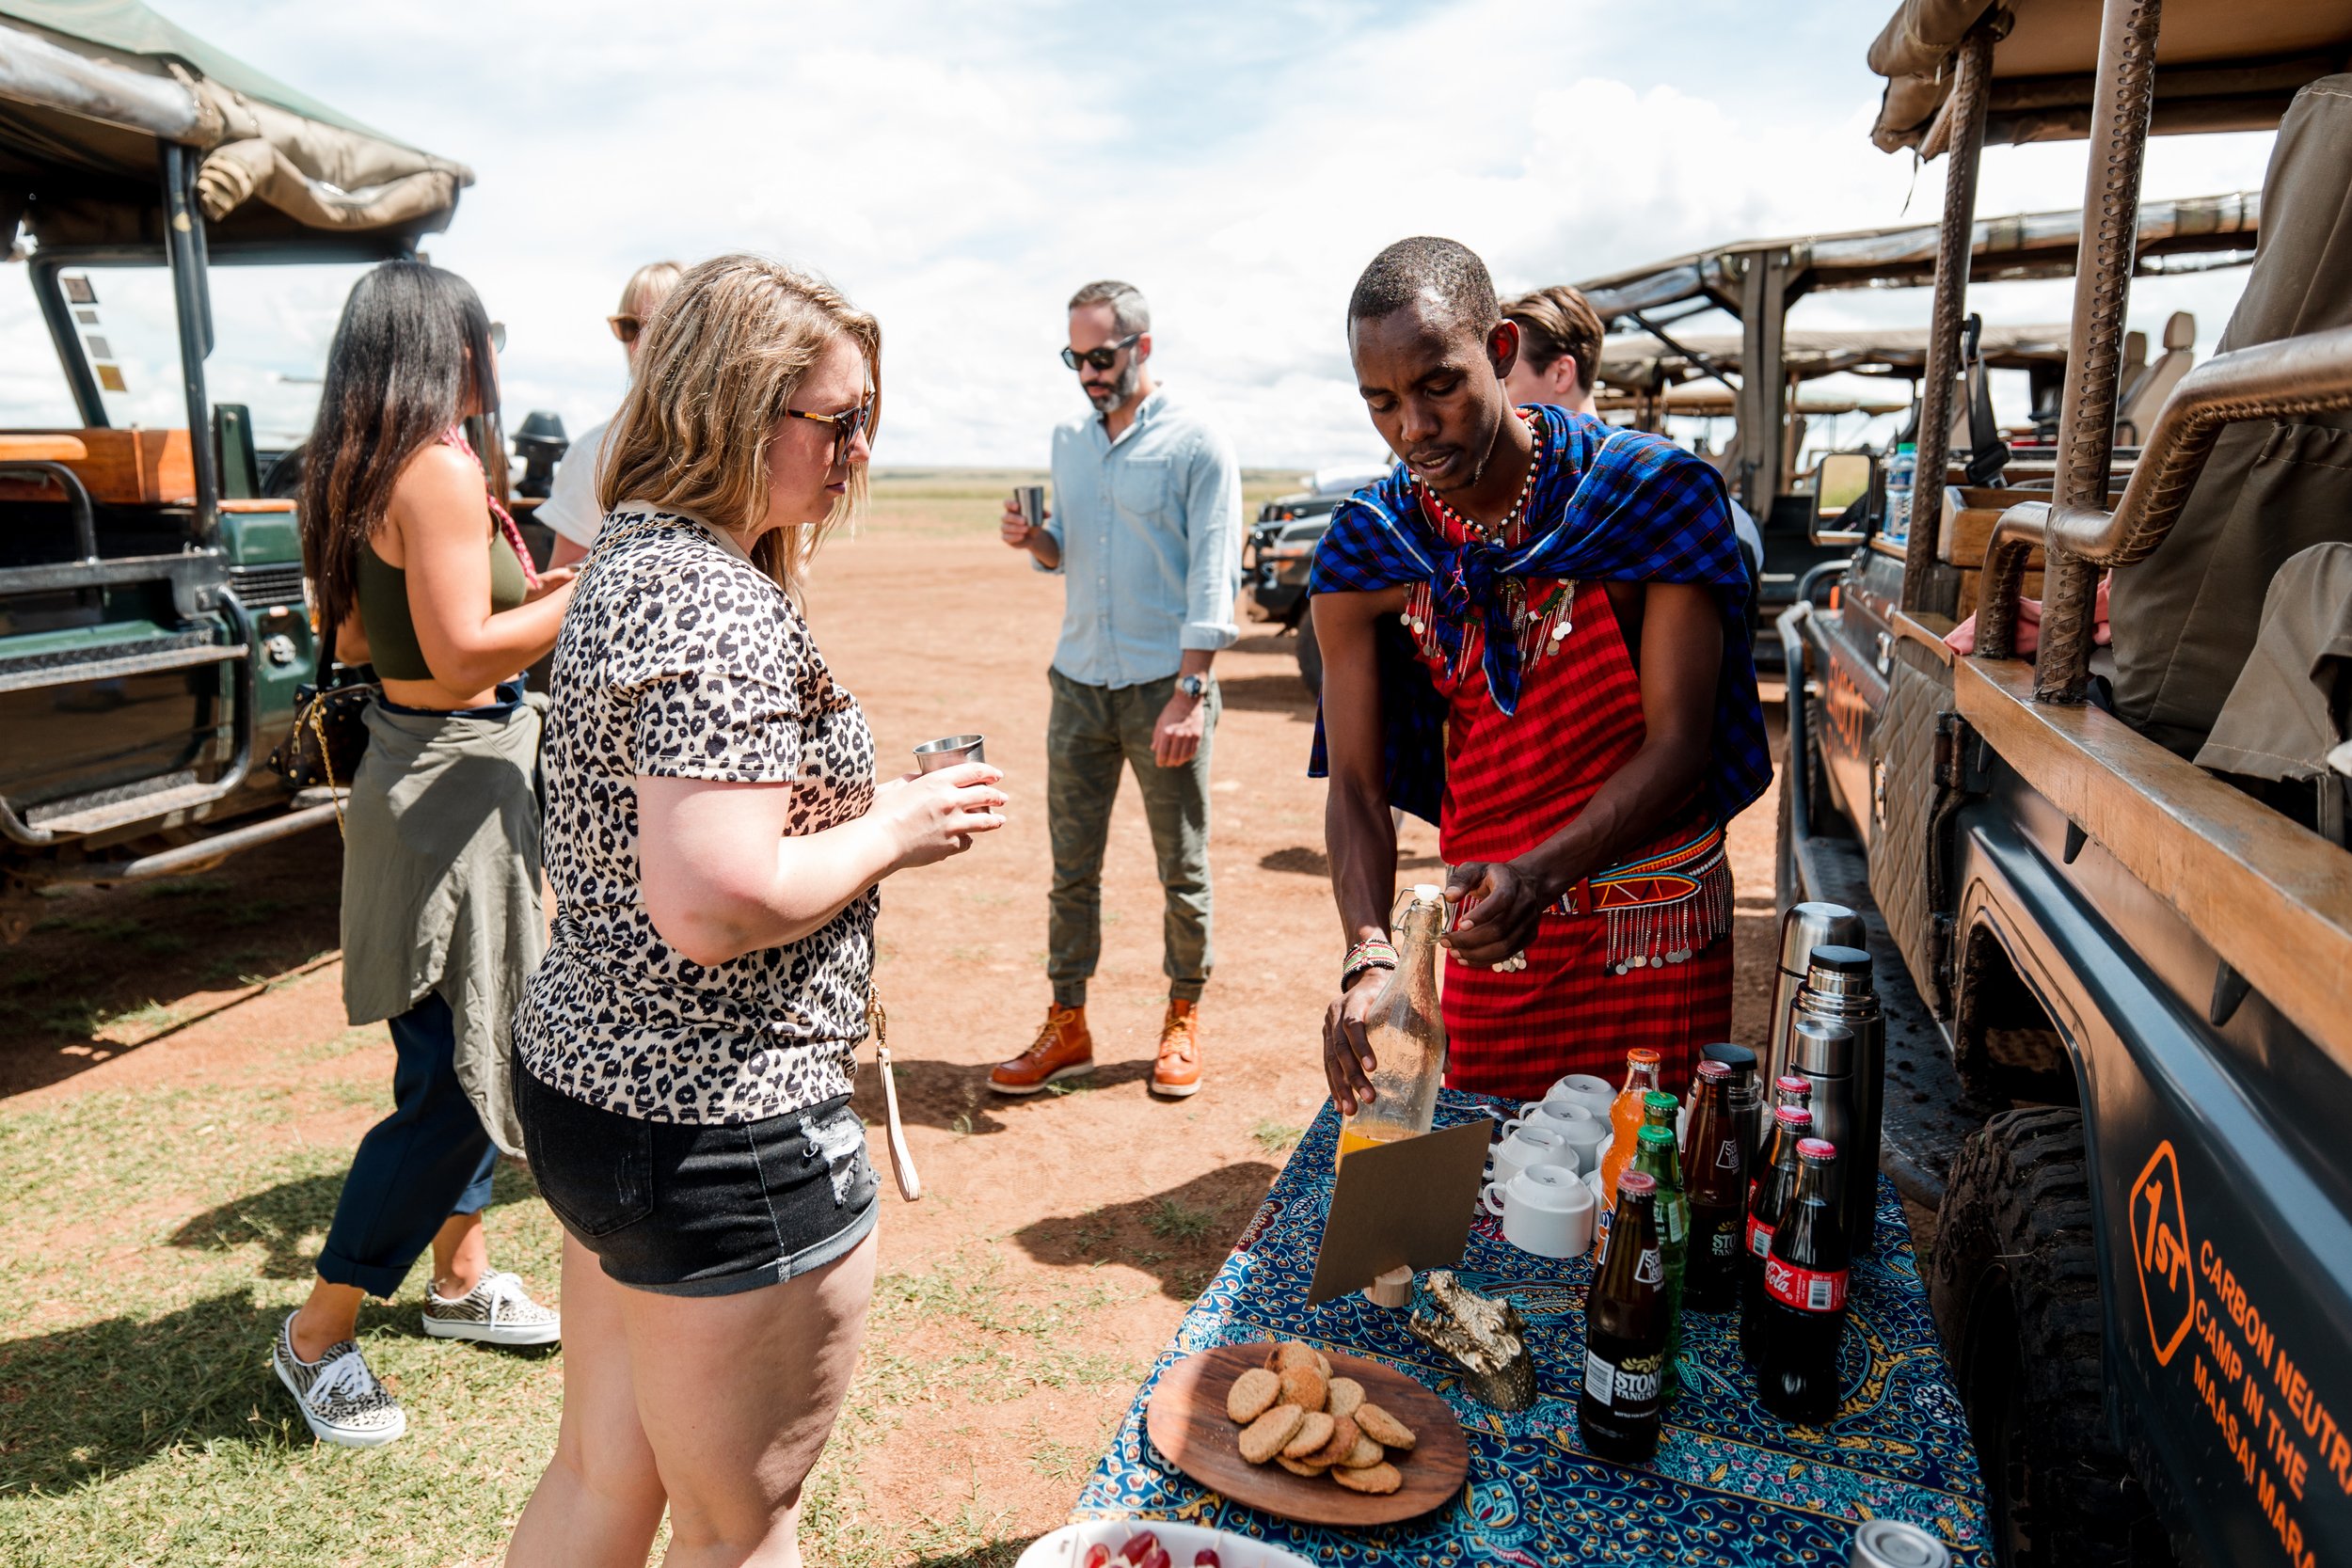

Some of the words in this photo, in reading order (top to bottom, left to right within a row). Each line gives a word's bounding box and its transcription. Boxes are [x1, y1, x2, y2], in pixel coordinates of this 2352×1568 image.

[1765, 1260, 1794, 1293] Cola
[2144, 1180, 2185, 1293] 1ST
[2194, 1354, 2257, 1486] MAASAI
[2196, 1298, 2243, 1384] CAMP
[2242, 1373, 2265, 1429] IN
[2267, 1408, 2309, 1502] THE
[2201, 1240, 2275, 1370] CARBON
[2274, 1349, 2352, 1496] NEUTR
